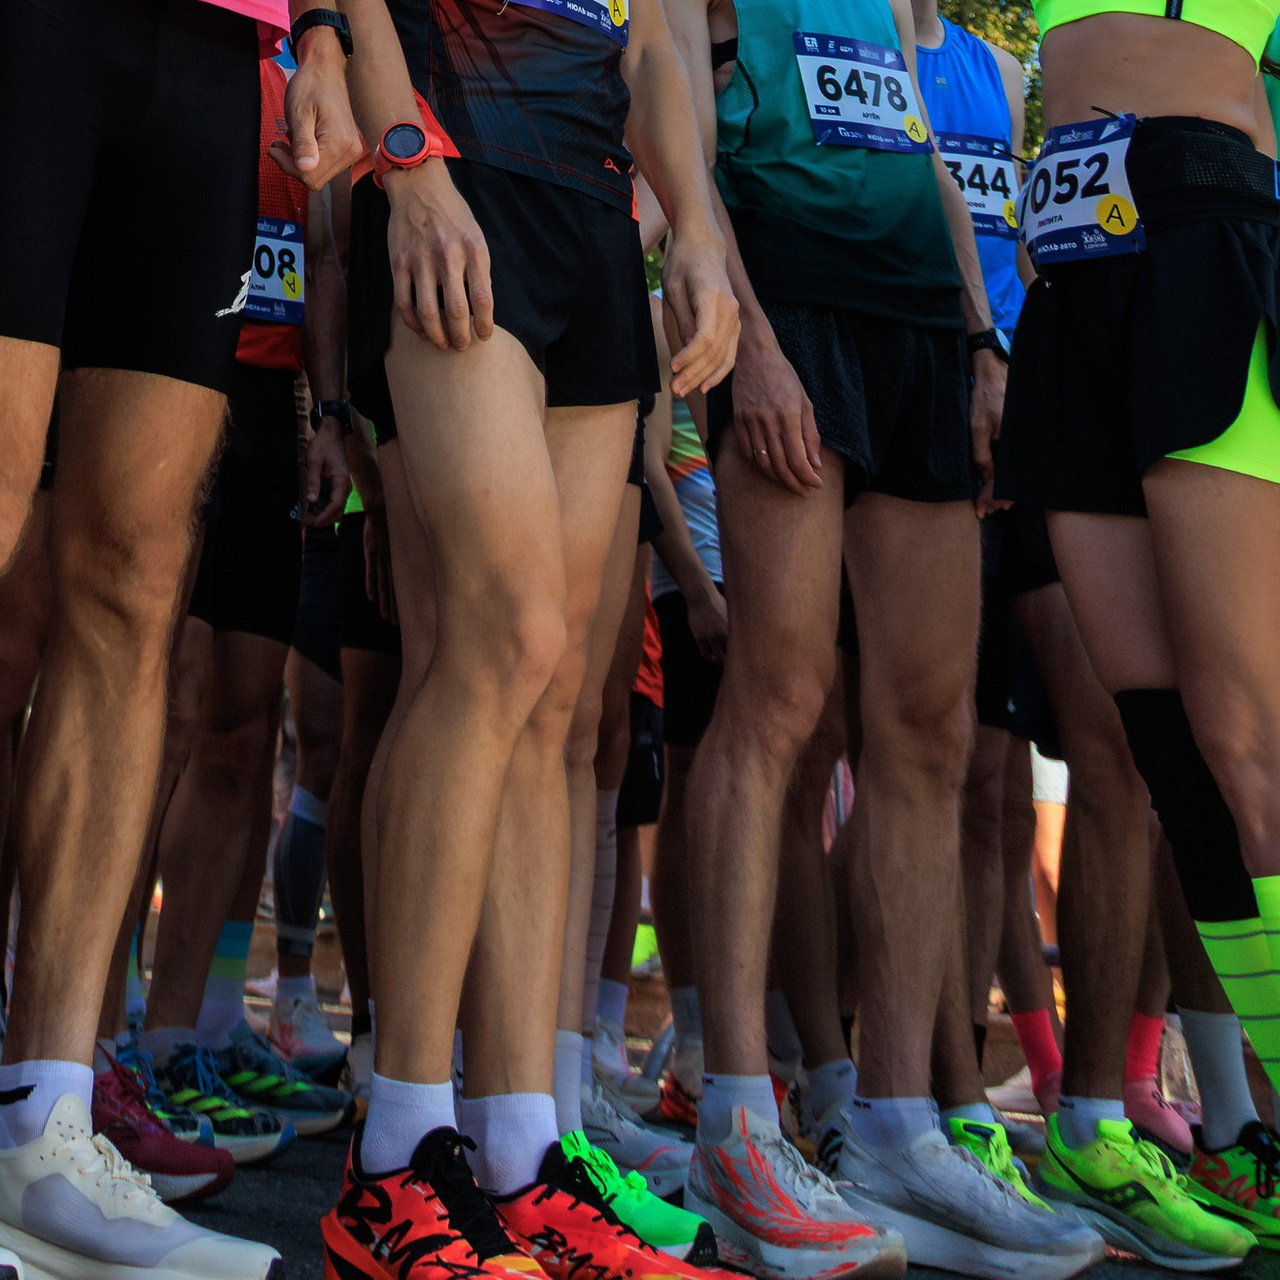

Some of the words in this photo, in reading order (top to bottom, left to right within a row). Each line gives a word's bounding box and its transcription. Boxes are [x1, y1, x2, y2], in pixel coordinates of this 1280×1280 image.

[816, 65, 908, 112] 6478
[944, 160, 1011, 199] 344
[1030, 152, 1109, 214] 052
[254, 244, 296, 281] 08
